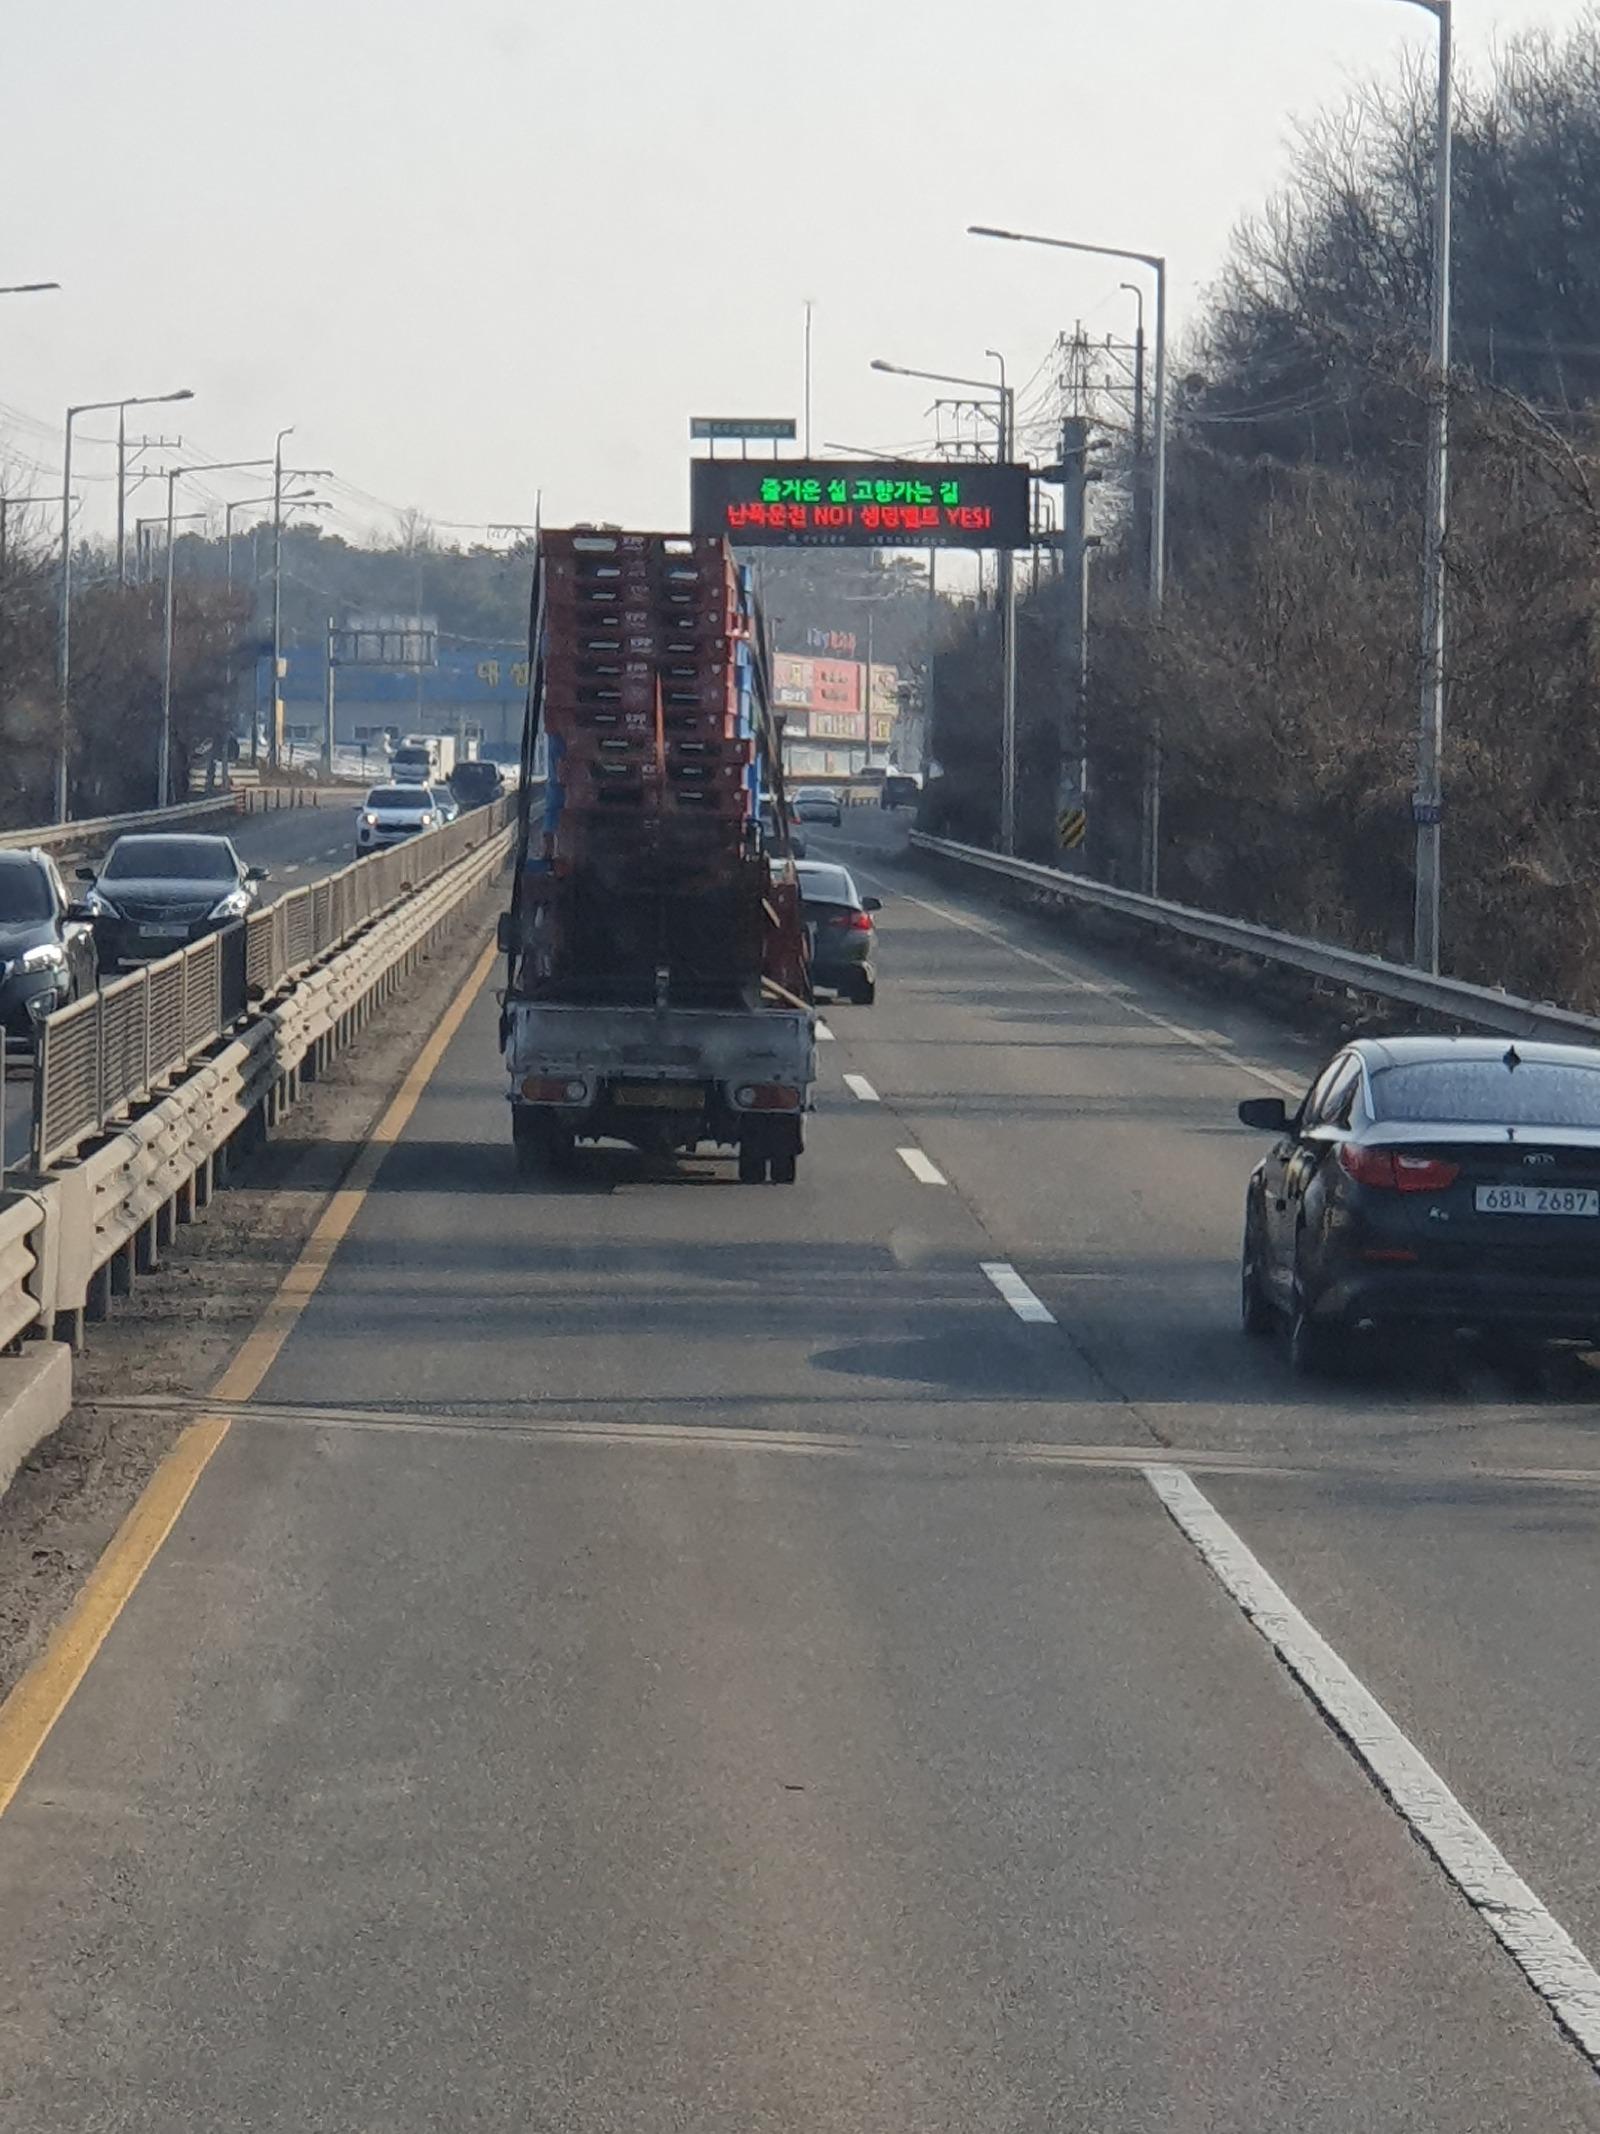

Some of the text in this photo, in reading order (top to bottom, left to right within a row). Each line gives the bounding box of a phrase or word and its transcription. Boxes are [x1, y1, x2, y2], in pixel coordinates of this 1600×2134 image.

[760, 477, 958, 503] 즐거운 설 고향가는 길
[727, 503, 807, 528] 난폭운전
[812, 506, 853, 527] NO!
[1536, 1191, 1588, 1212] 2687
